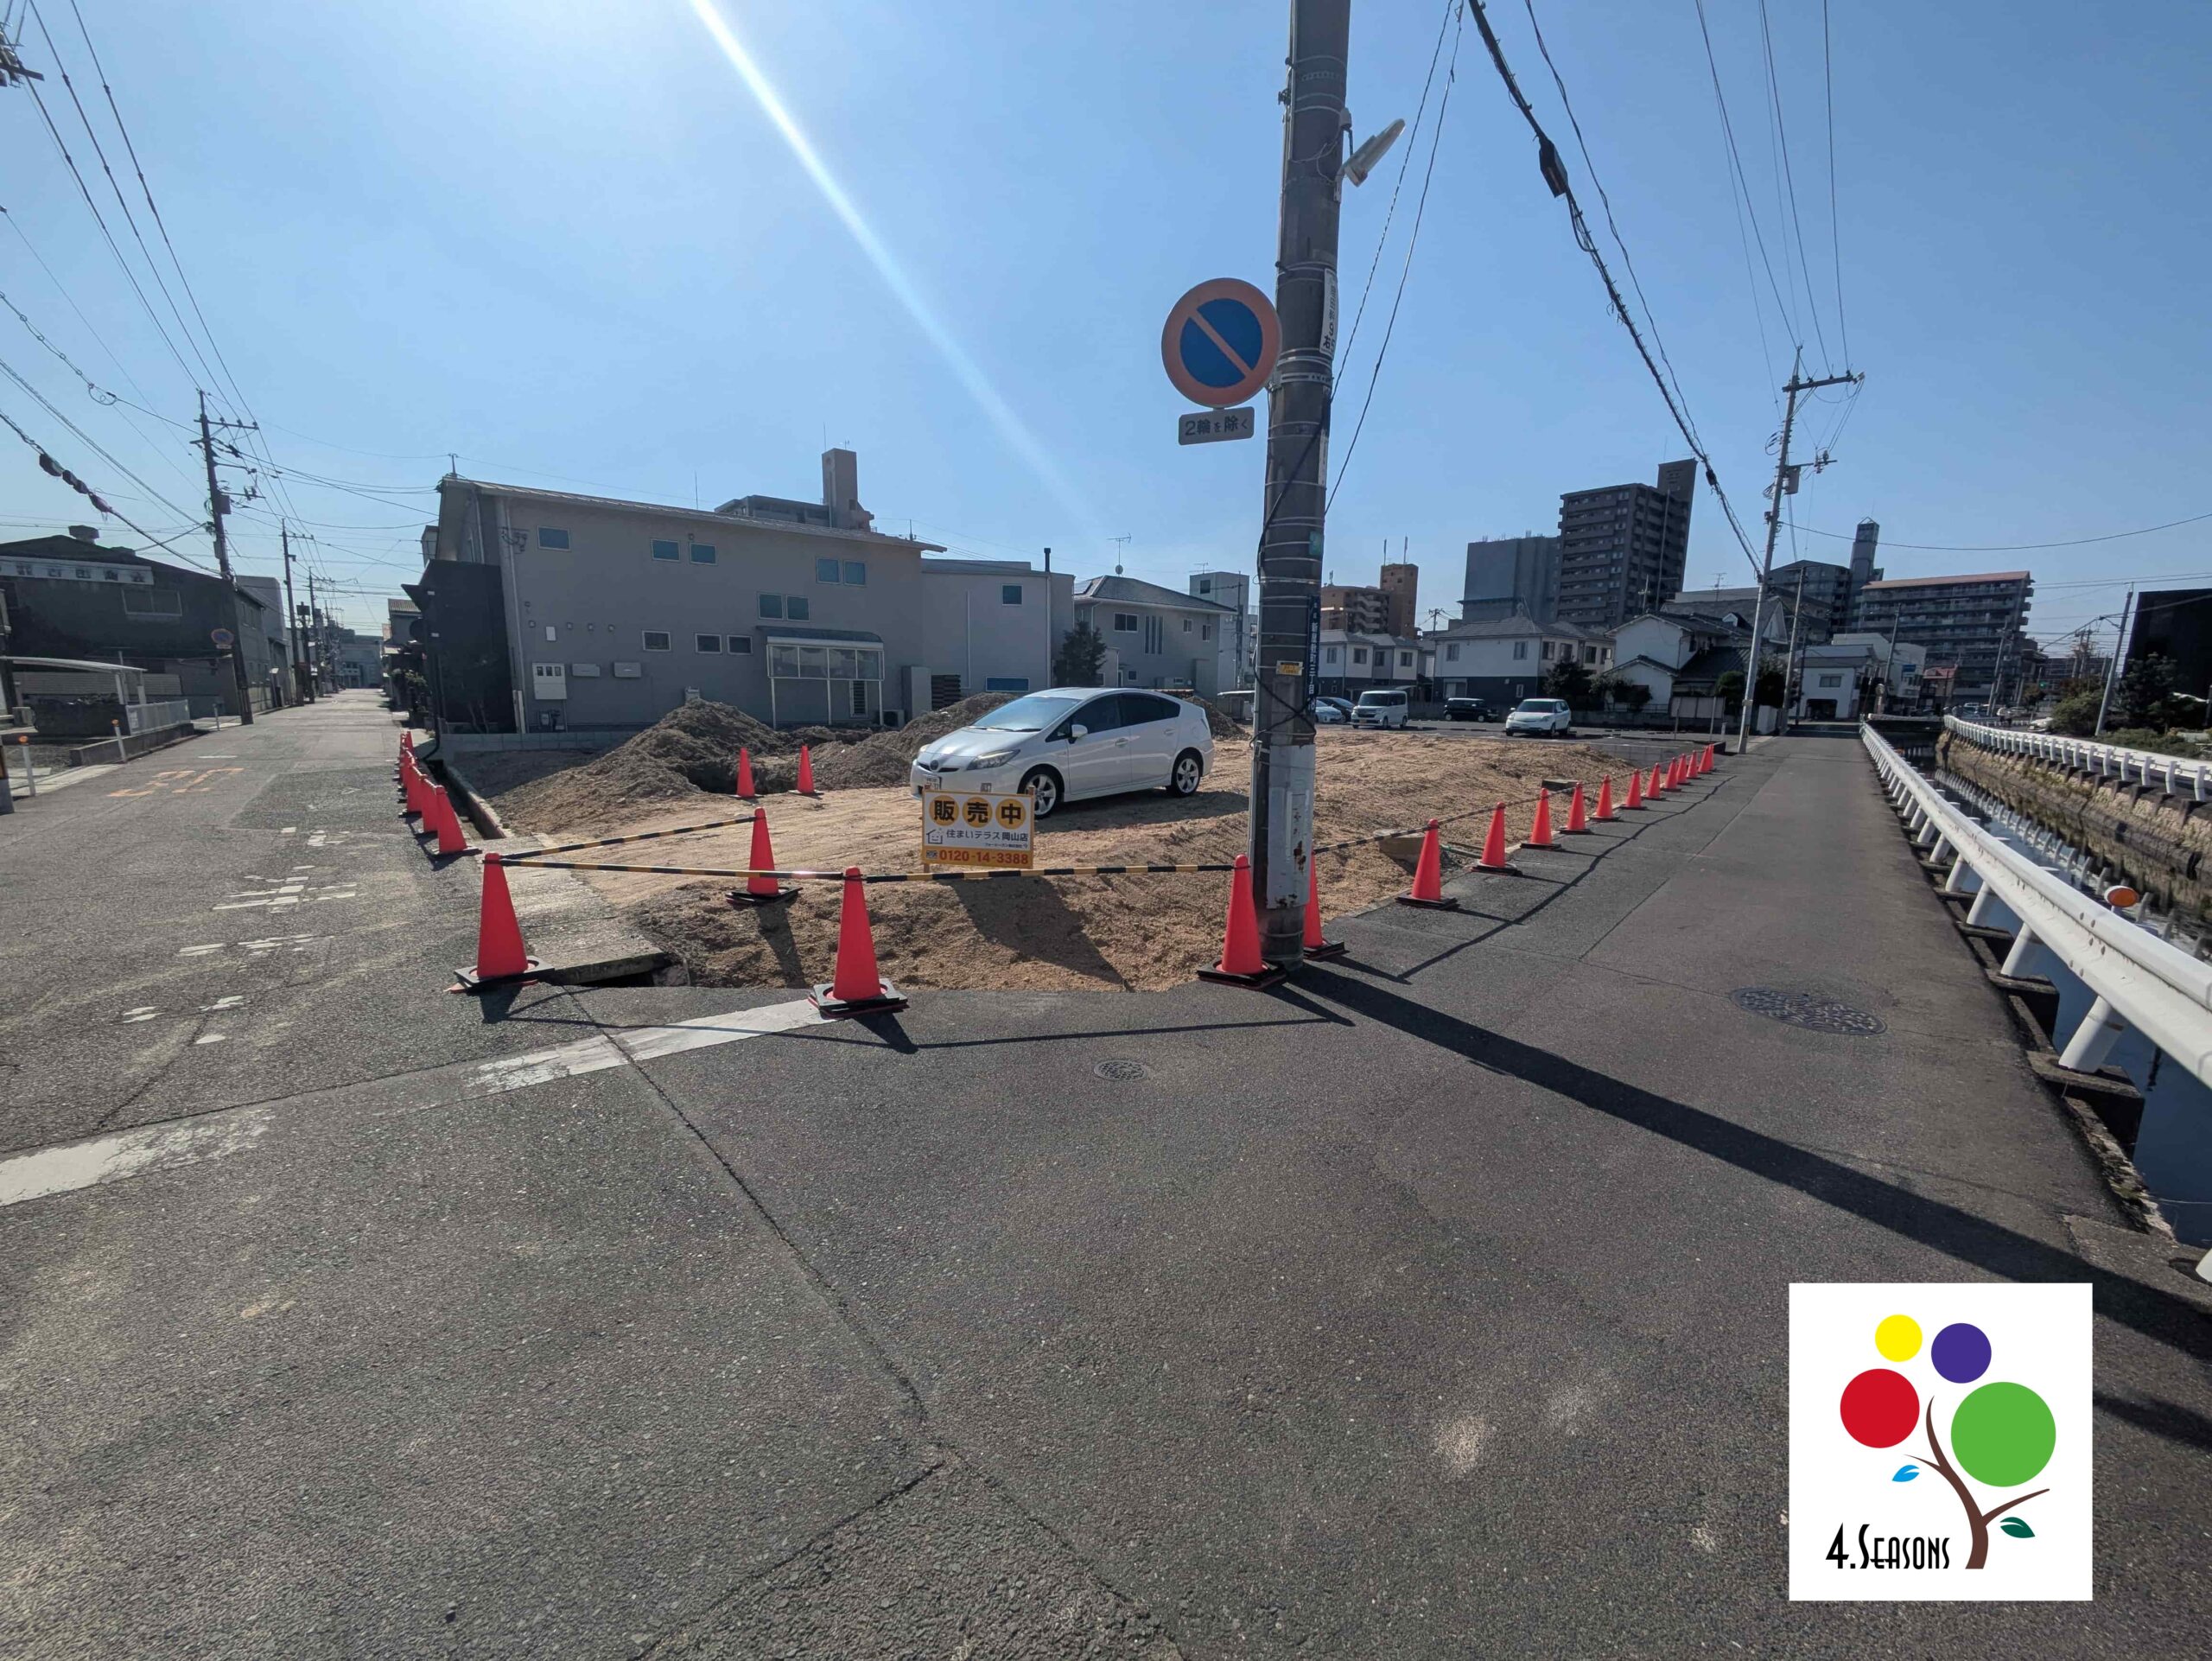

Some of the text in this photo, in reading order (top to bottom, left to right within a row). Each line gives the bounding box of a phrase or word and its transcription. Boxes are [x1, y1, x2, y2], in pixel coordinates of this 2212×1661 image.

[1185, 415, 1249, 436] 2輪を除く
[933, 800, 1021, 824] 販売中
[939, 850, 1028, 864] 0120-14-3388
